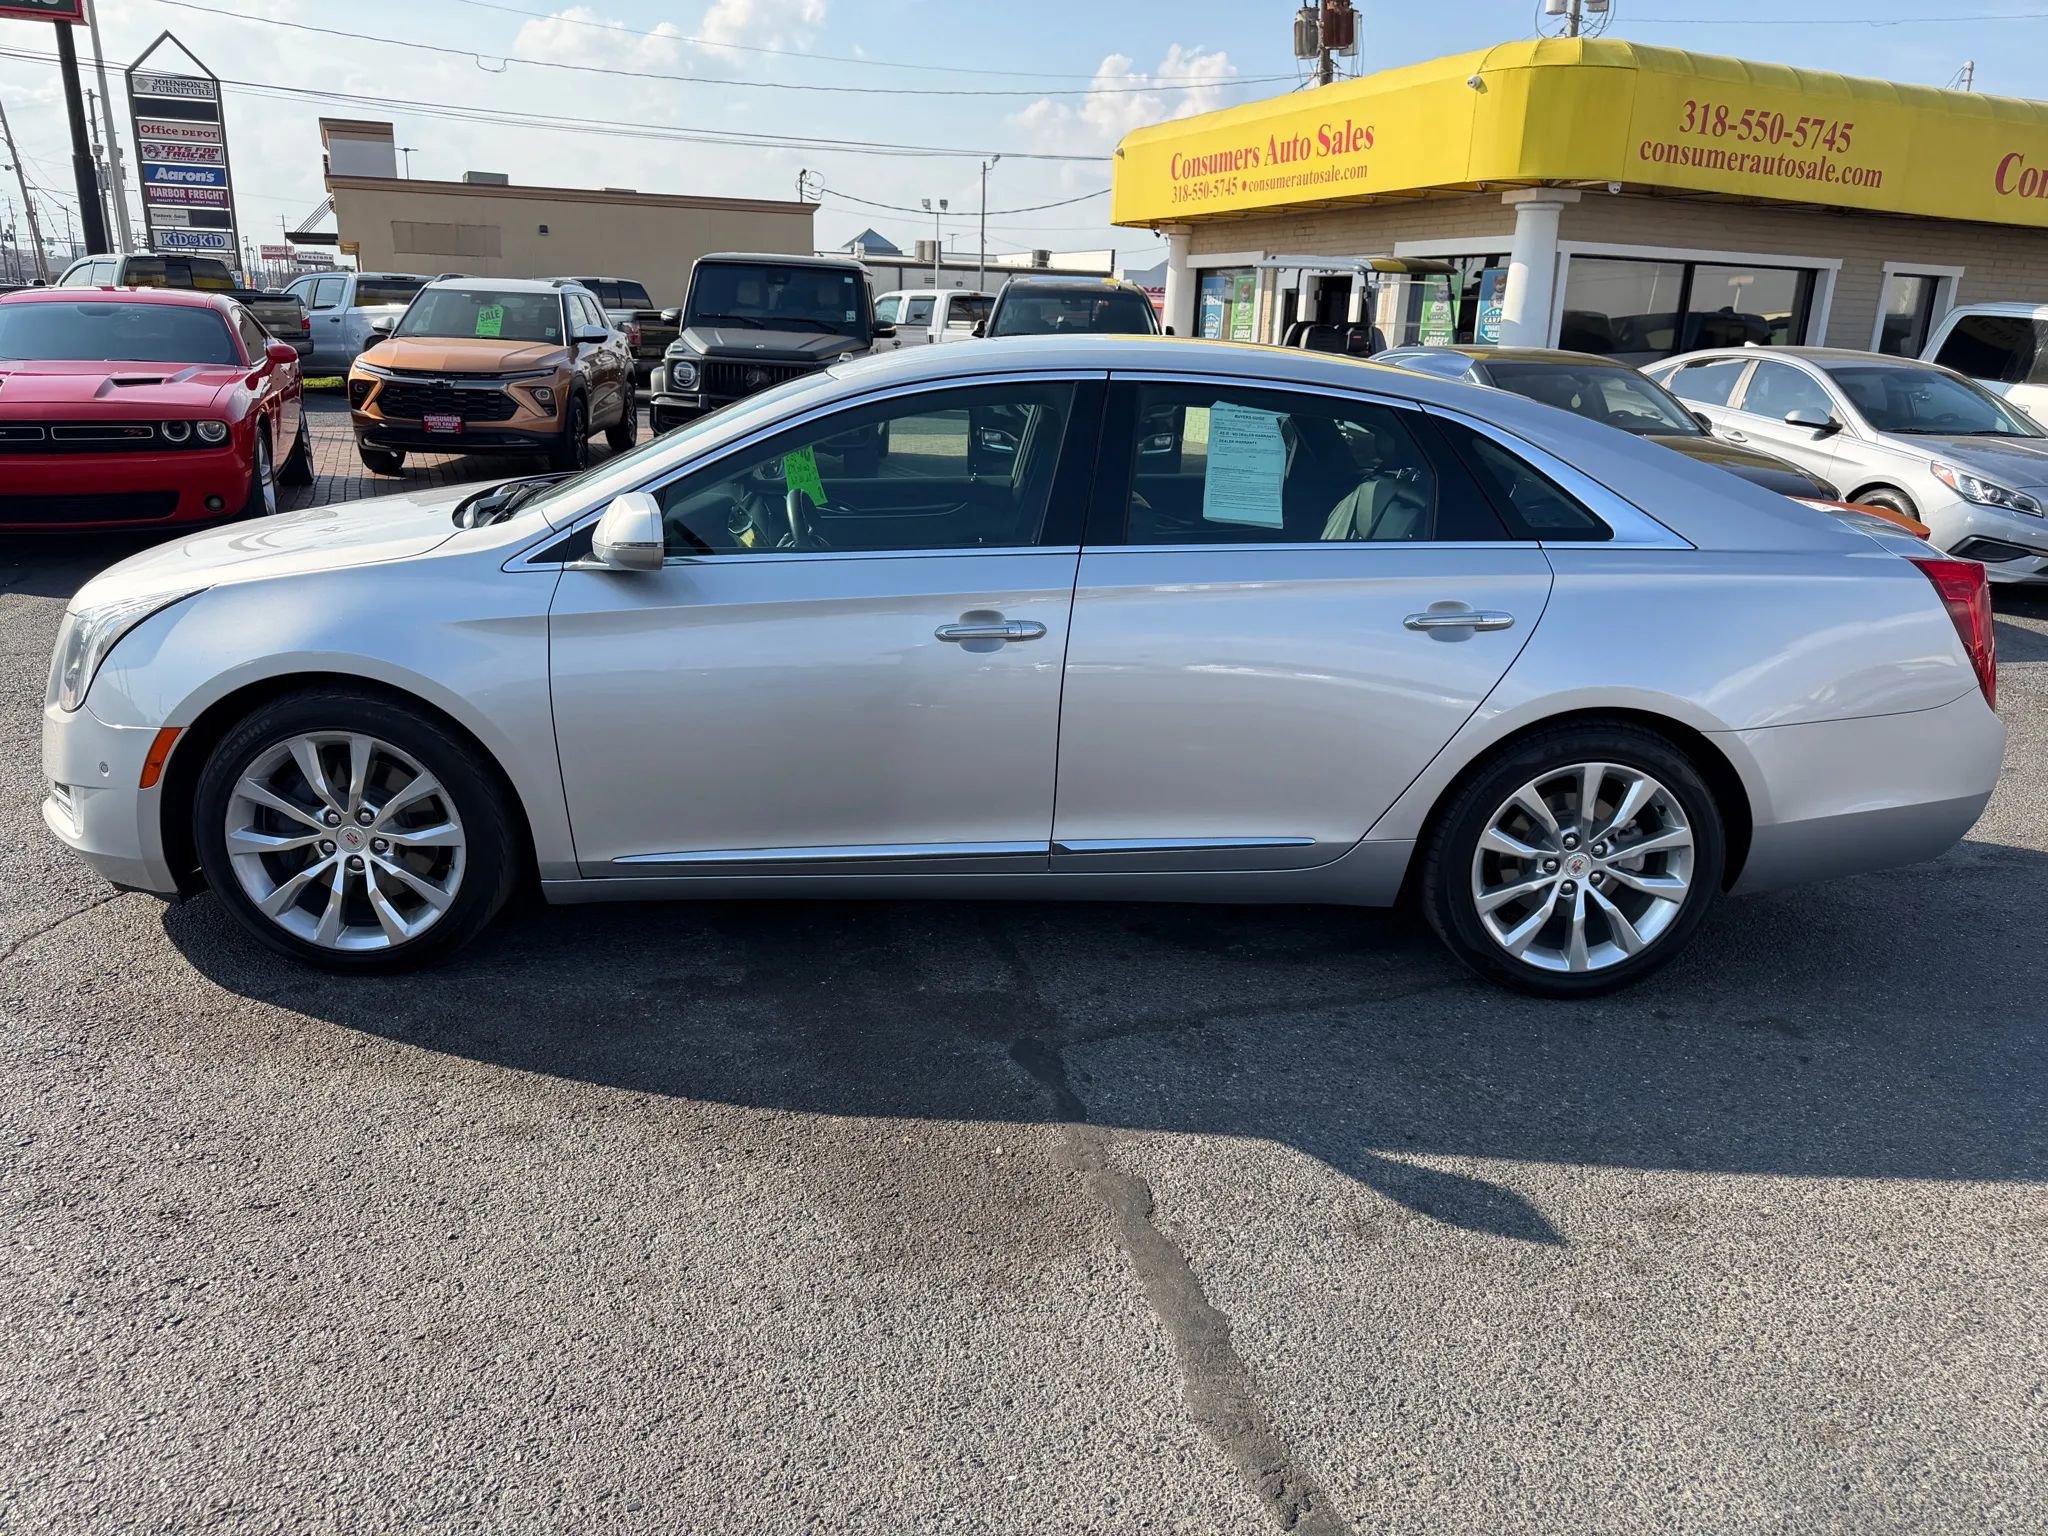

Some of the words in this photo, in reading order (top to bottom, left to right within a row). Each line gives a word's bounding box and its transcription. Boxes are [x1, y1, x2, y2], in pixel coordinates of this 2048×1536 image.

[151, 85, 213, 96] FURNITURE
[152, 79, 210, 89] JOHNSON'S
[140, 124, 178, 136] Office
[181, 129, 217, 138] DEPOT
[1679, 100, 1854, 154] 318-550-5745
[160, 144, 193, 153] TOYS
[165, 150, 217, 160] TRUCKS
[1170, 145, 1260, 181] Consumers
[1264, 132, 1311, 166] Auto
[1316, 119, 1375, 157] Sales
[1640, 139, 1883, 189] consumerautosale.com
[155, 167, 215, 183] Aaron's
[1171, 176, 1238, 203] 318-550-5745
[1248, 164, 1368, 193] consumerautosale.com
[149, 188, 186, 198] HARBOR
[188, 189, 225, 201] FREIGHT
[480, 309, 500, 322] SALE
